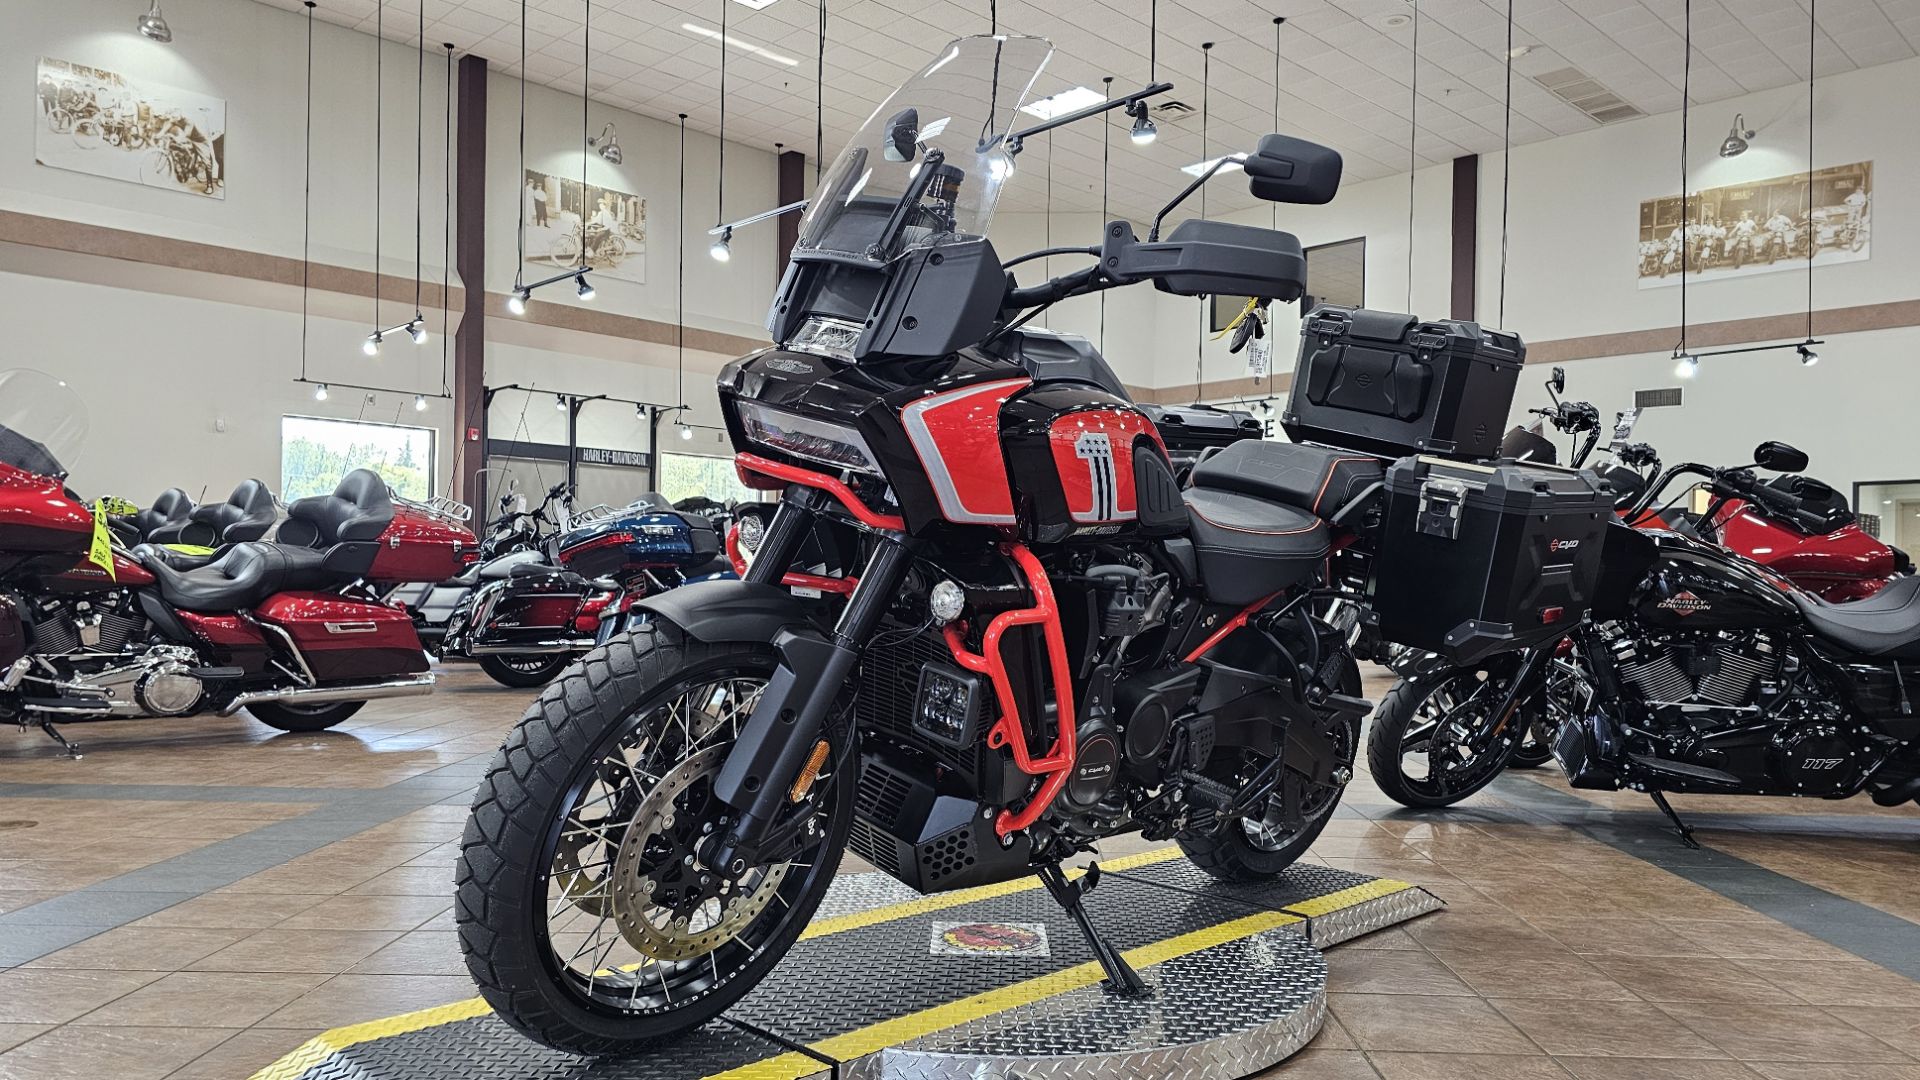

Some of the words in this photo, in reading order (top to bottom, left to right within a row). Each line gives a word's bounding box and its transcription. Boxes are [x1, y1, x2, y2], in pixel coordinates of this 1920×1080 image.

[583, 448, 647, 466] HARLEY-DAVIDSON
[1558, 539, 1580, 550] CVO
[1656, 602, 1711, 611] DAVIDSON
[1801, 758, 1844, 770] 117
[622, 945, 766, 1015] HARLEY-DAVIDSON
